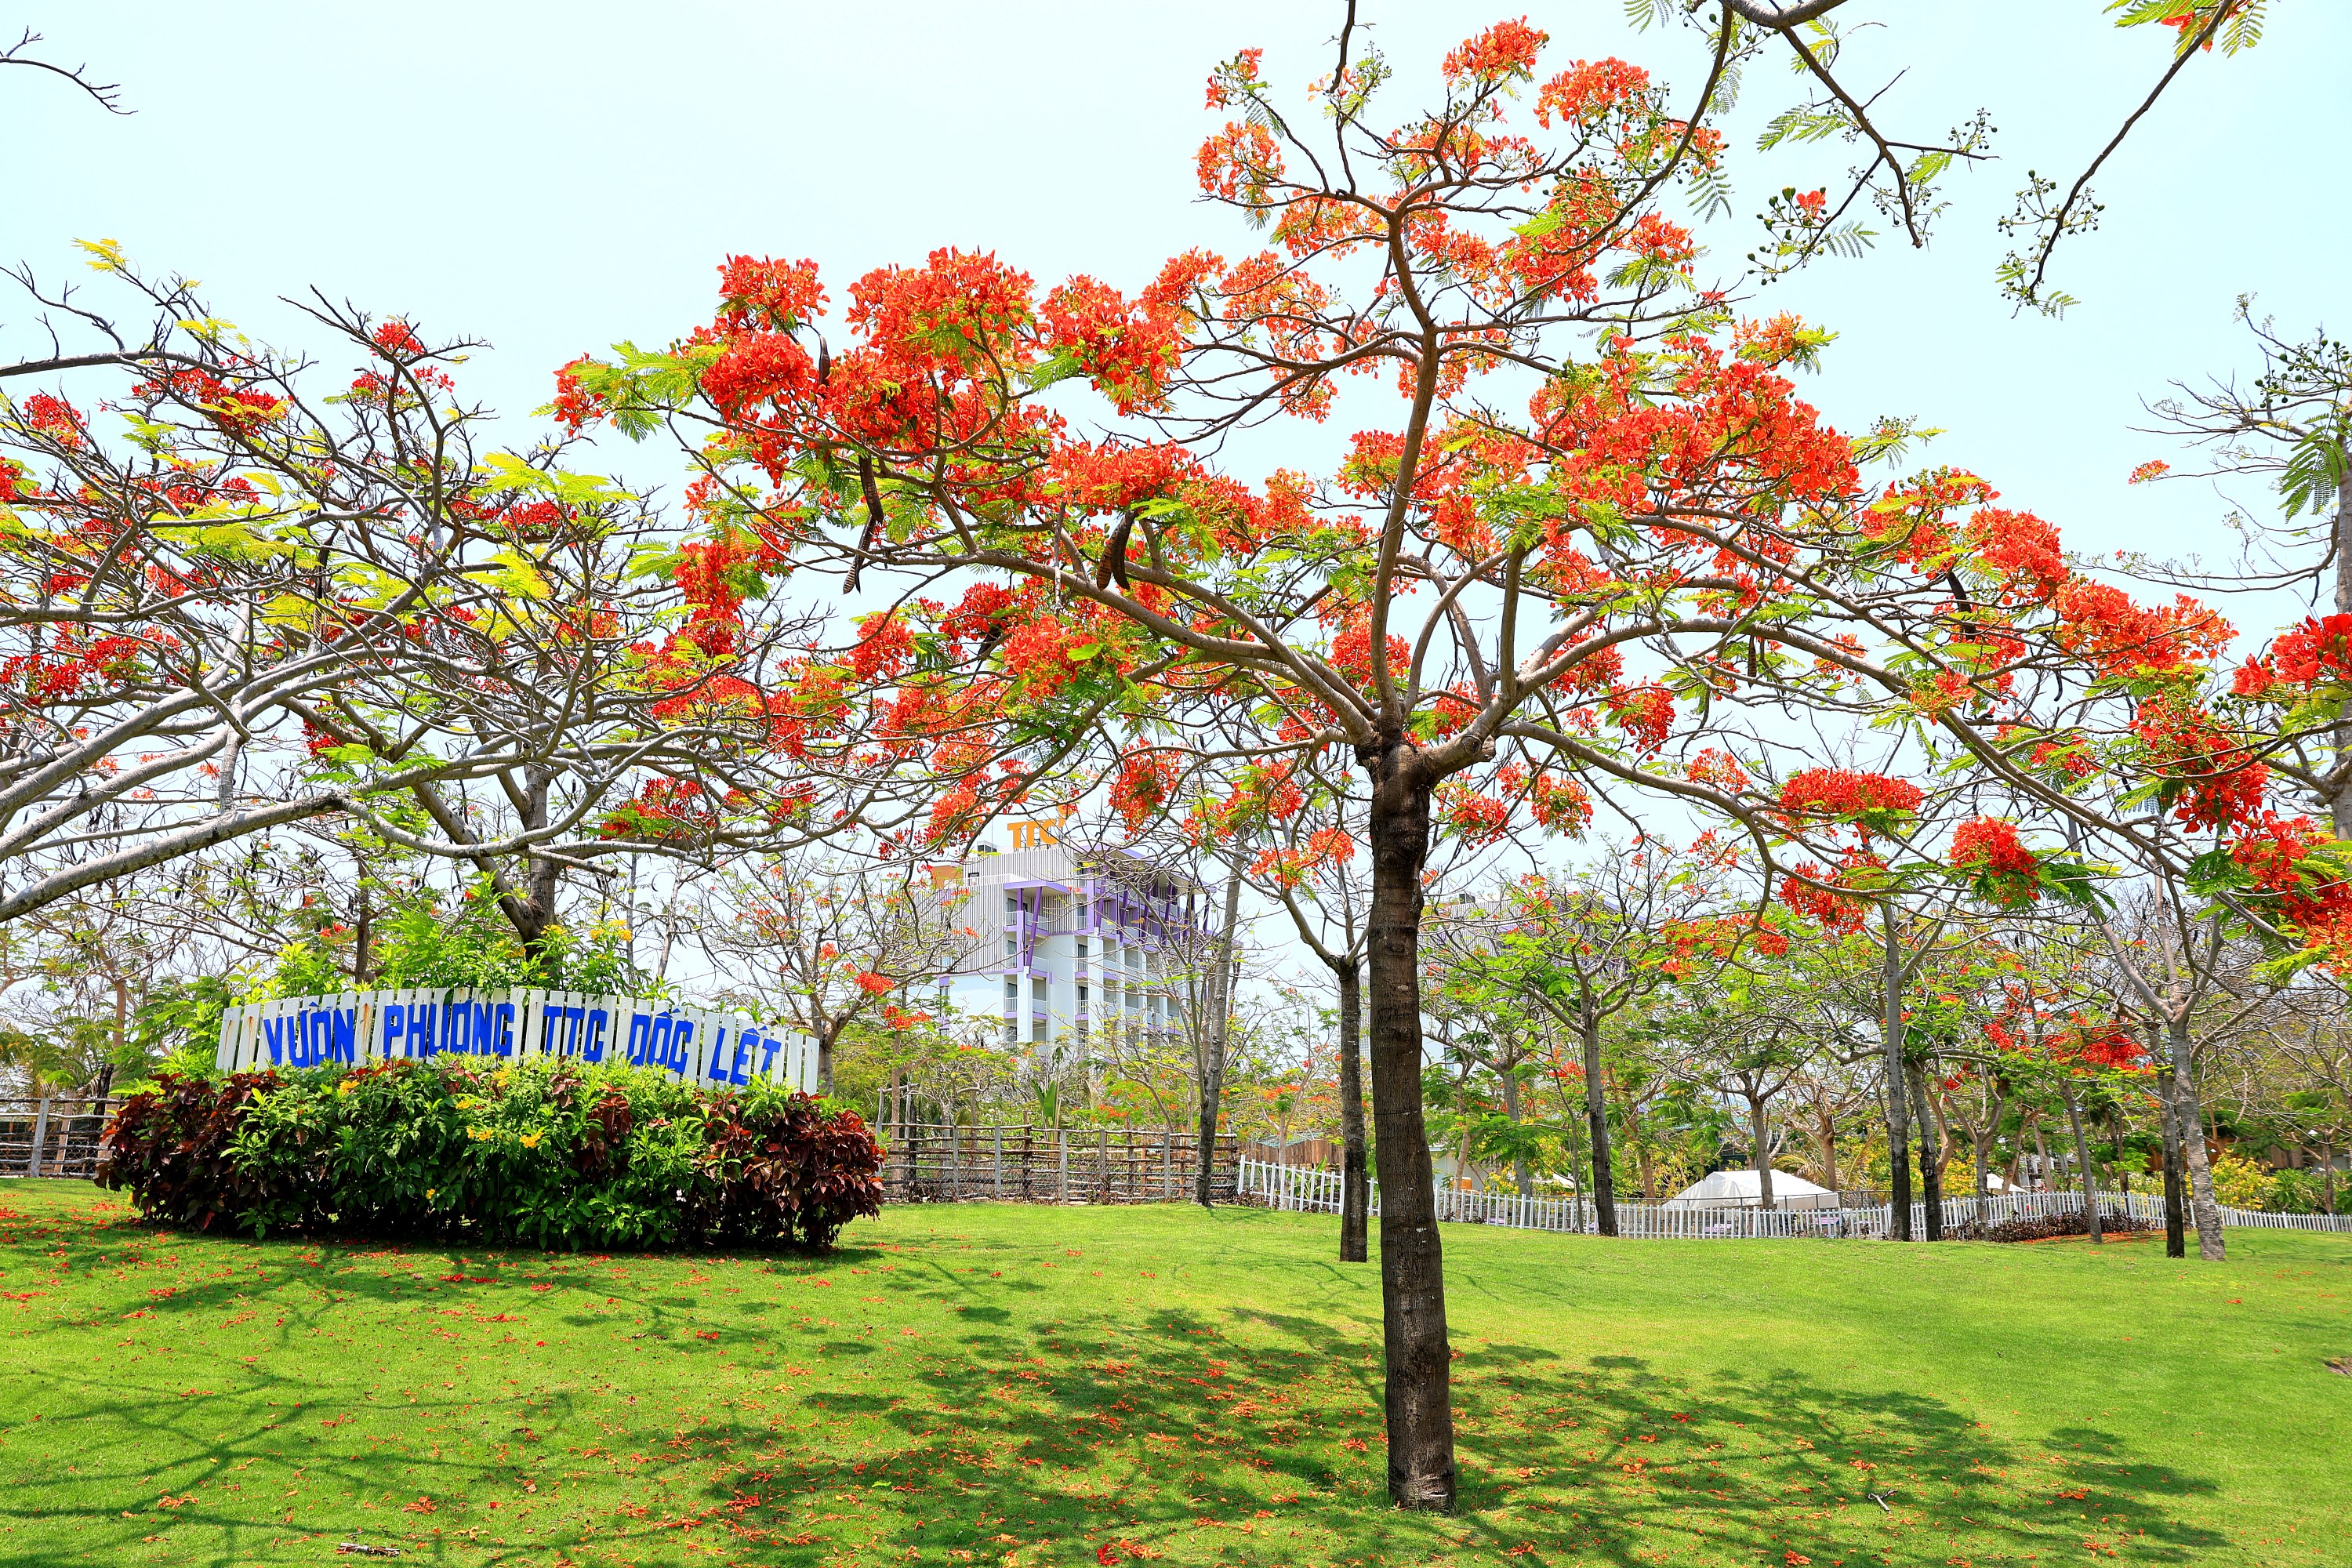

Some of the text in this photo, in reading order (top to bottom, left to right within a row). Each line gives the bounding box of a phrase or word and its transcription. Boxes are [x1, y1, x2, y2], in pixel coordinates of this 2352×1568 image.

[1007, 818, 1060, 848] TTC
[543, 1005, 608, 1062] TTC
[709, 1025, 782, 1086] LẾT
